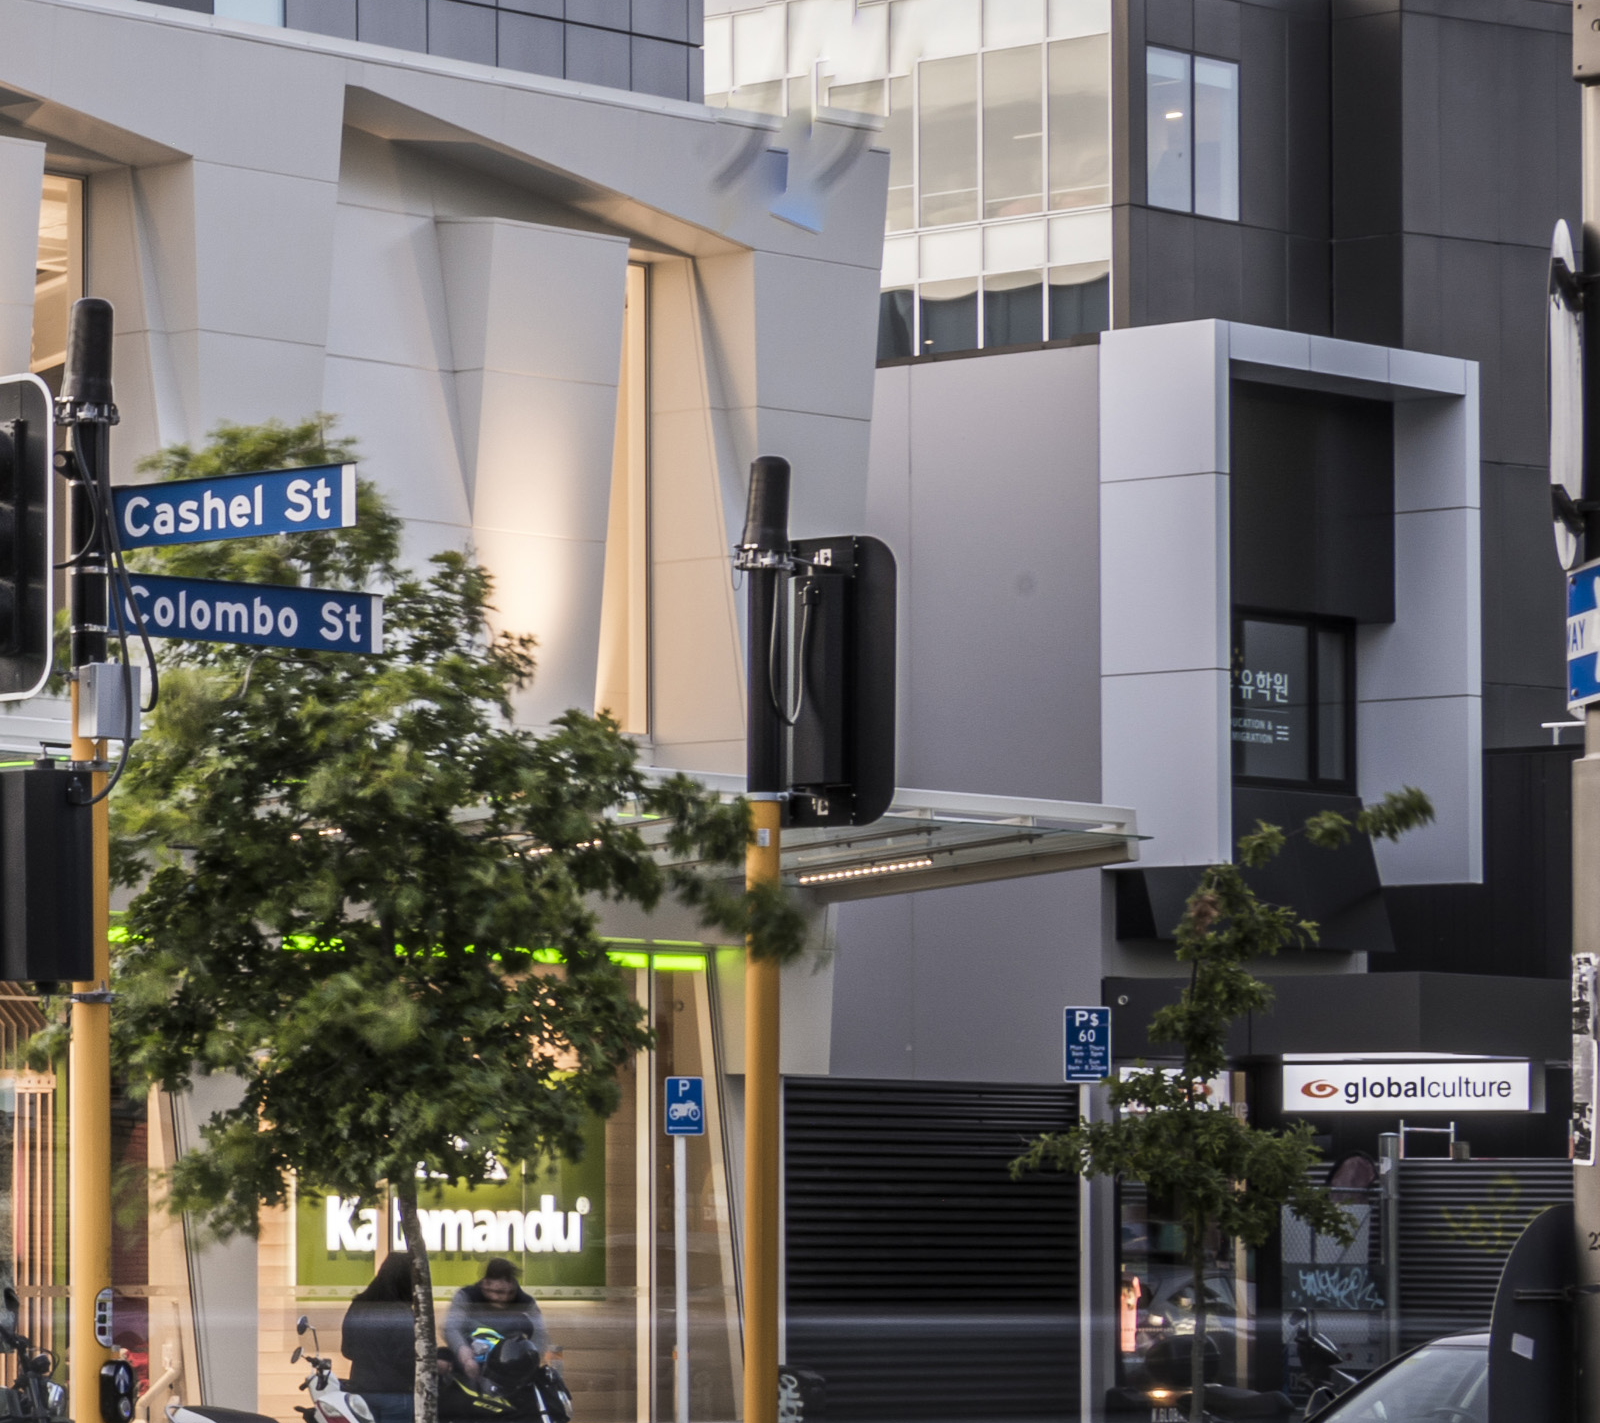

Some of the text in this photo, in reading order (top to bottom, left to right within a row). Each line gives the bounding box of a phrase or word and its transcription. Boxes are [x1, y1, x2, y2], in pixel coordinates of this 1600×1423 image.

[124, 478, 332, 538] Cashel St
[124, 585, 362, 643] Colombo St
[1079, 1029, 1096, 1043] 60
[679, 1080, 690, 1097] P
[1344, 1076, 1512, 1104] globalculture
